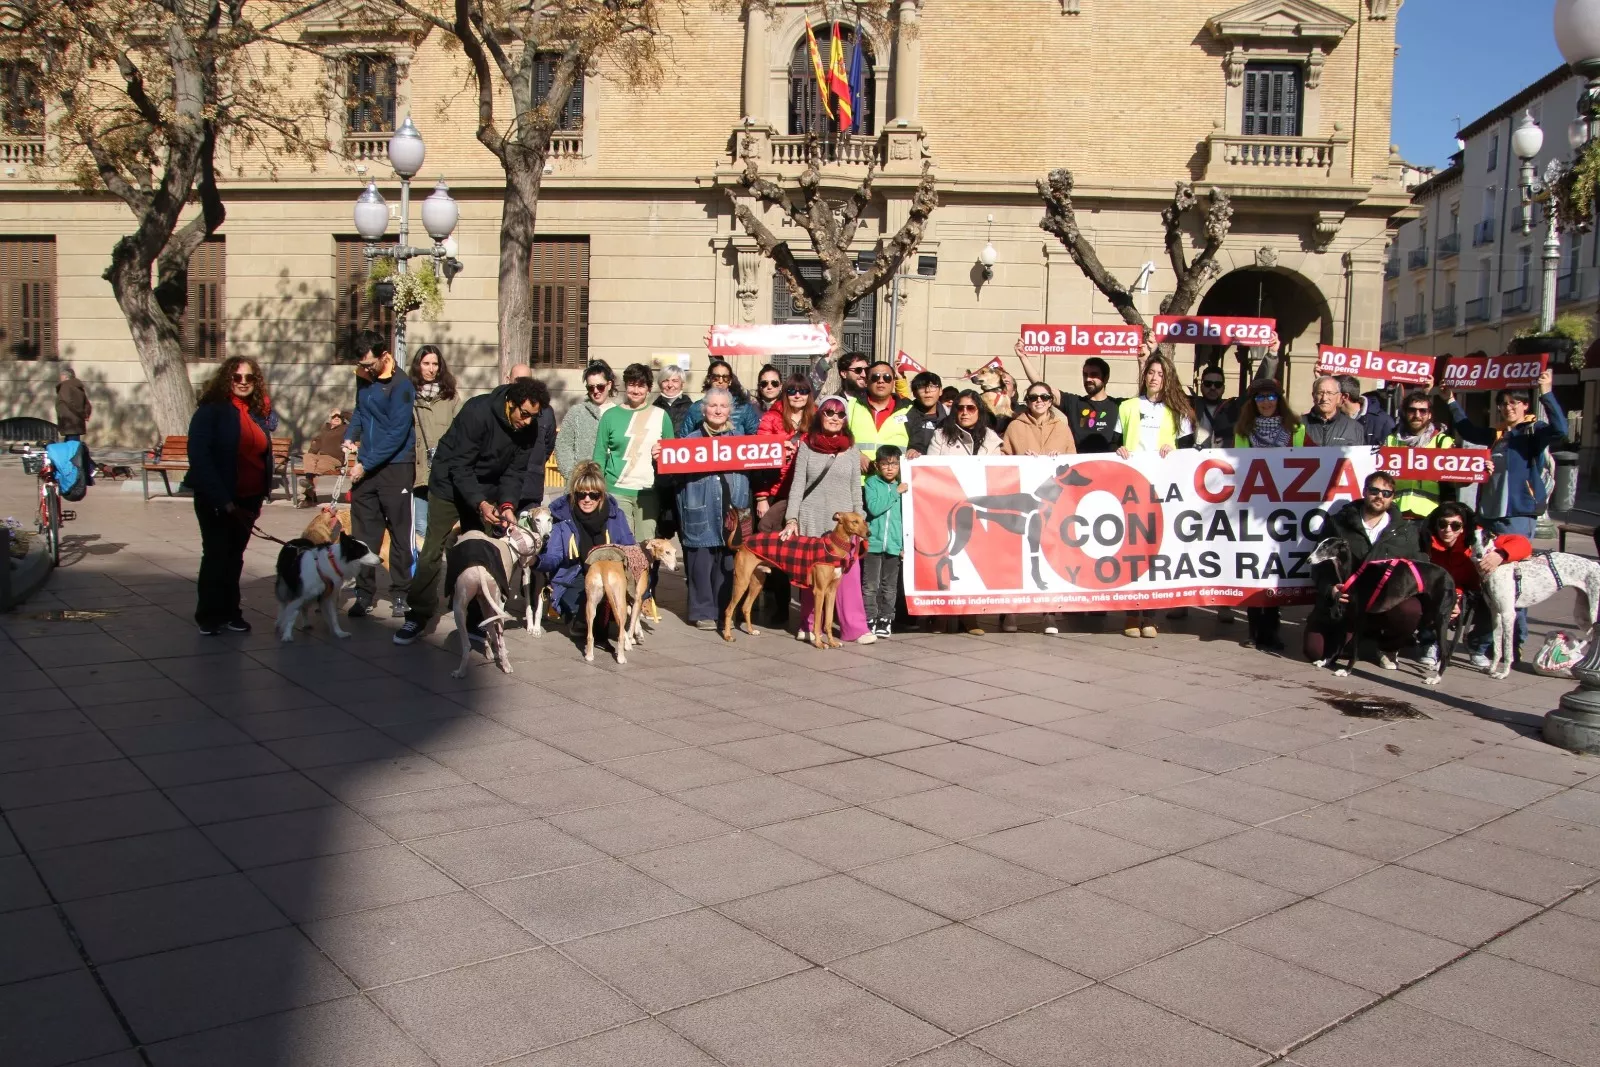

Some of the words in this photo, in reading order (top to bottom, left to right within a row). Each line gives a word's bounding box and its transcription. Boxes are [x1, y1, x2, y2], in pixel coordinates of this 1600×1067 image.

[1024, 330, 1050, 345] no
[1054, 330, 1066, 346] a
[1071, 325, 1089, 346] la
[1093, 331, 1139, 347] caza
[1155, 321, 1182, 336] no
[1186, 323, 1198, 336] a
[1203, 318, 1221, 337] la
[1225, 323, 1271, 339] caza
[1039, 345, 1065, 353] perros
[1320, 363, 1334, 371] con
[1334, 365, 1359, 374] perros
[1321, 350, 1347, 366] no
[1349, 354, 1361, 368] a
[1365, 351, 1384, 371] la
[1386, 358, 1430, 376] caza
[1444, 363, 1468, 379] no
[1470, 363, 1482, 379] a
[1483, 358, 1501, 379] la
[1502, 361, 1541, 378] caza
[1454, 379, 1477, 388] perros
[661, 446, 691, 465] no
[694, 446, 708, 463] a
[712, 439, 732, 462] la
[736, 442, 783, 460] caza
[1388, 453, 1402, 469] a
[1407, 448, 1428, 470] la
[1433, 455, 1485, 473] caza
[1122, 484, 1140, 505] A
[1150, 483, 1184, 504] LA
[1193, 457, 1364, 504] CAZA
[911, 460, 1164, 591] NO
[1059, 511, 1157, 548] CON
[1065, 565, 1081, 585] Y
[1094, 551, 1222, 584] OTRAS
[913, 597, 945, 606] Cuanto
[948, 597, 966, 605] más
[1091, 593, 1110, 601] más
[1112, 592, 1150, 600] derecho
[1151, 591, 1174, 599] tiene
[1183, 589, 1197, 597] ser
[1199, 587, 1244, 597] defendida
